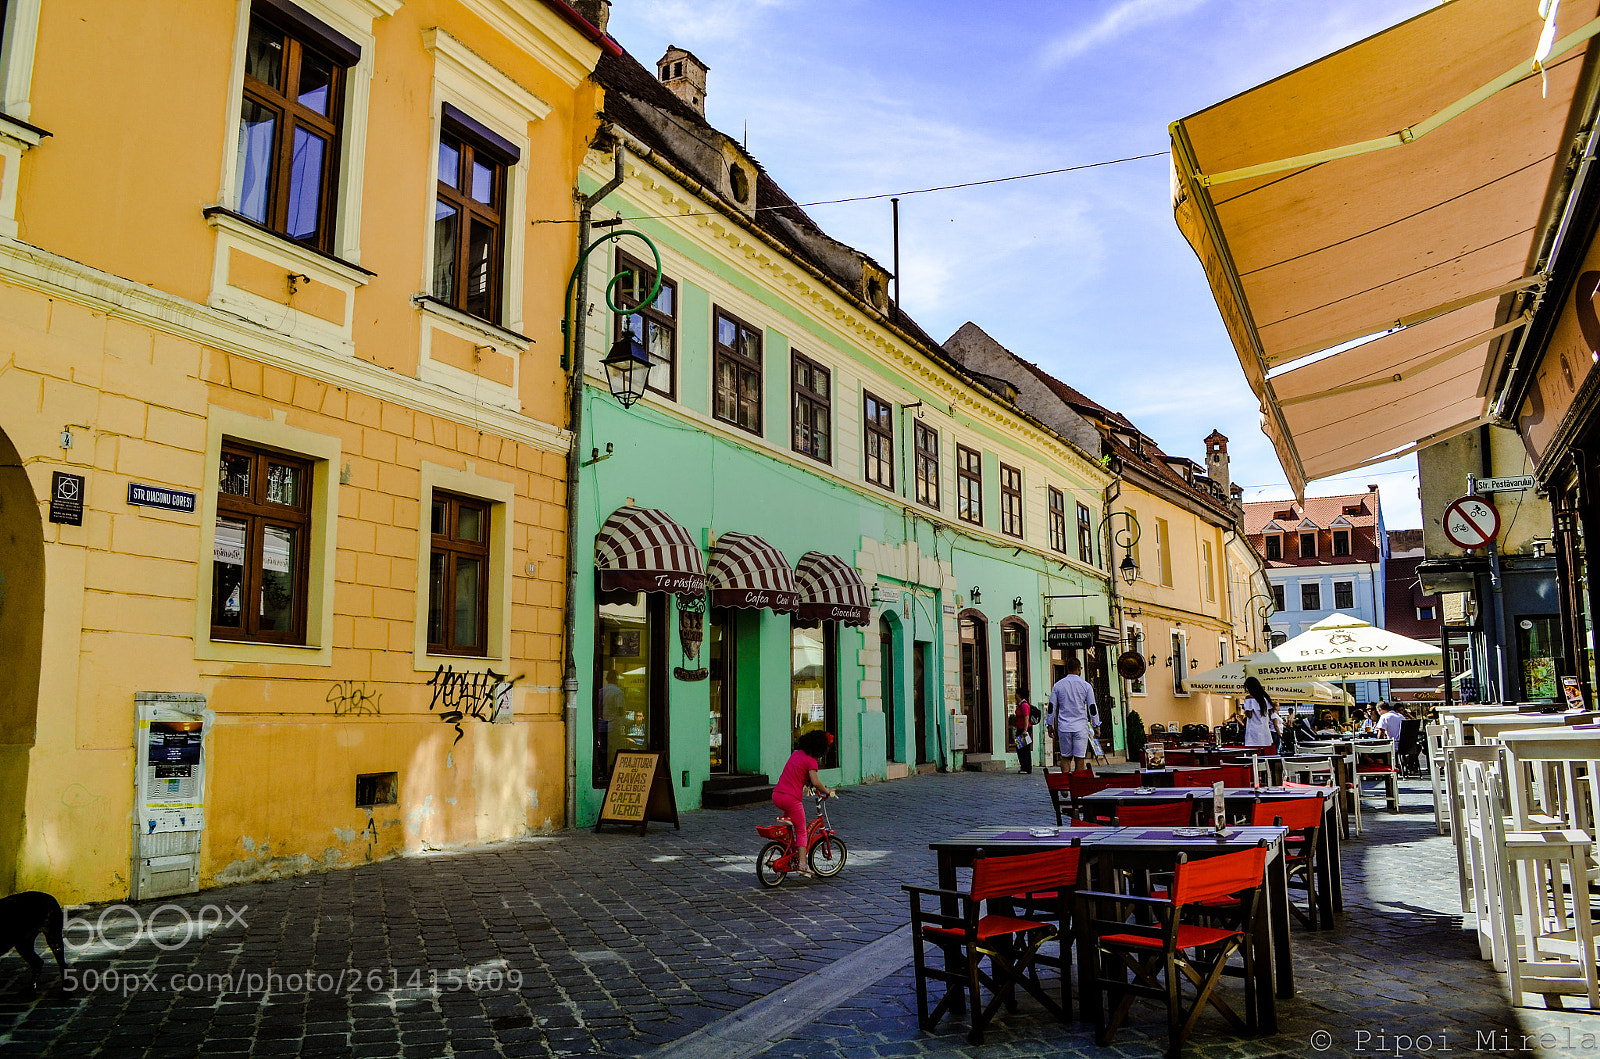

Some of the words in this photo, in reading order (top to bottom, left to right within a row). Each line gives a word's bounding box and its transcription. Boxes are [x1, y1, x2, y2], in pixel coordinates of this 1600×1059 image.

[1478, 481, 1490, 489] Str.
[146, 490, 171, 505] DIACONU
[655, 574, 671, 587] Te
[745, 590, 769, 606] Cafea
[1296, 663, 1327, 672] REGELE
[1378, 658, 1389, 667] ÎN
[1392, 657, 1439, 668] ROMÂNIA.
[617, 772, 647, 784] RAVAS
[610, 791, 641, 804] CAFEA
[612, 803, 643, 817] VERDE
